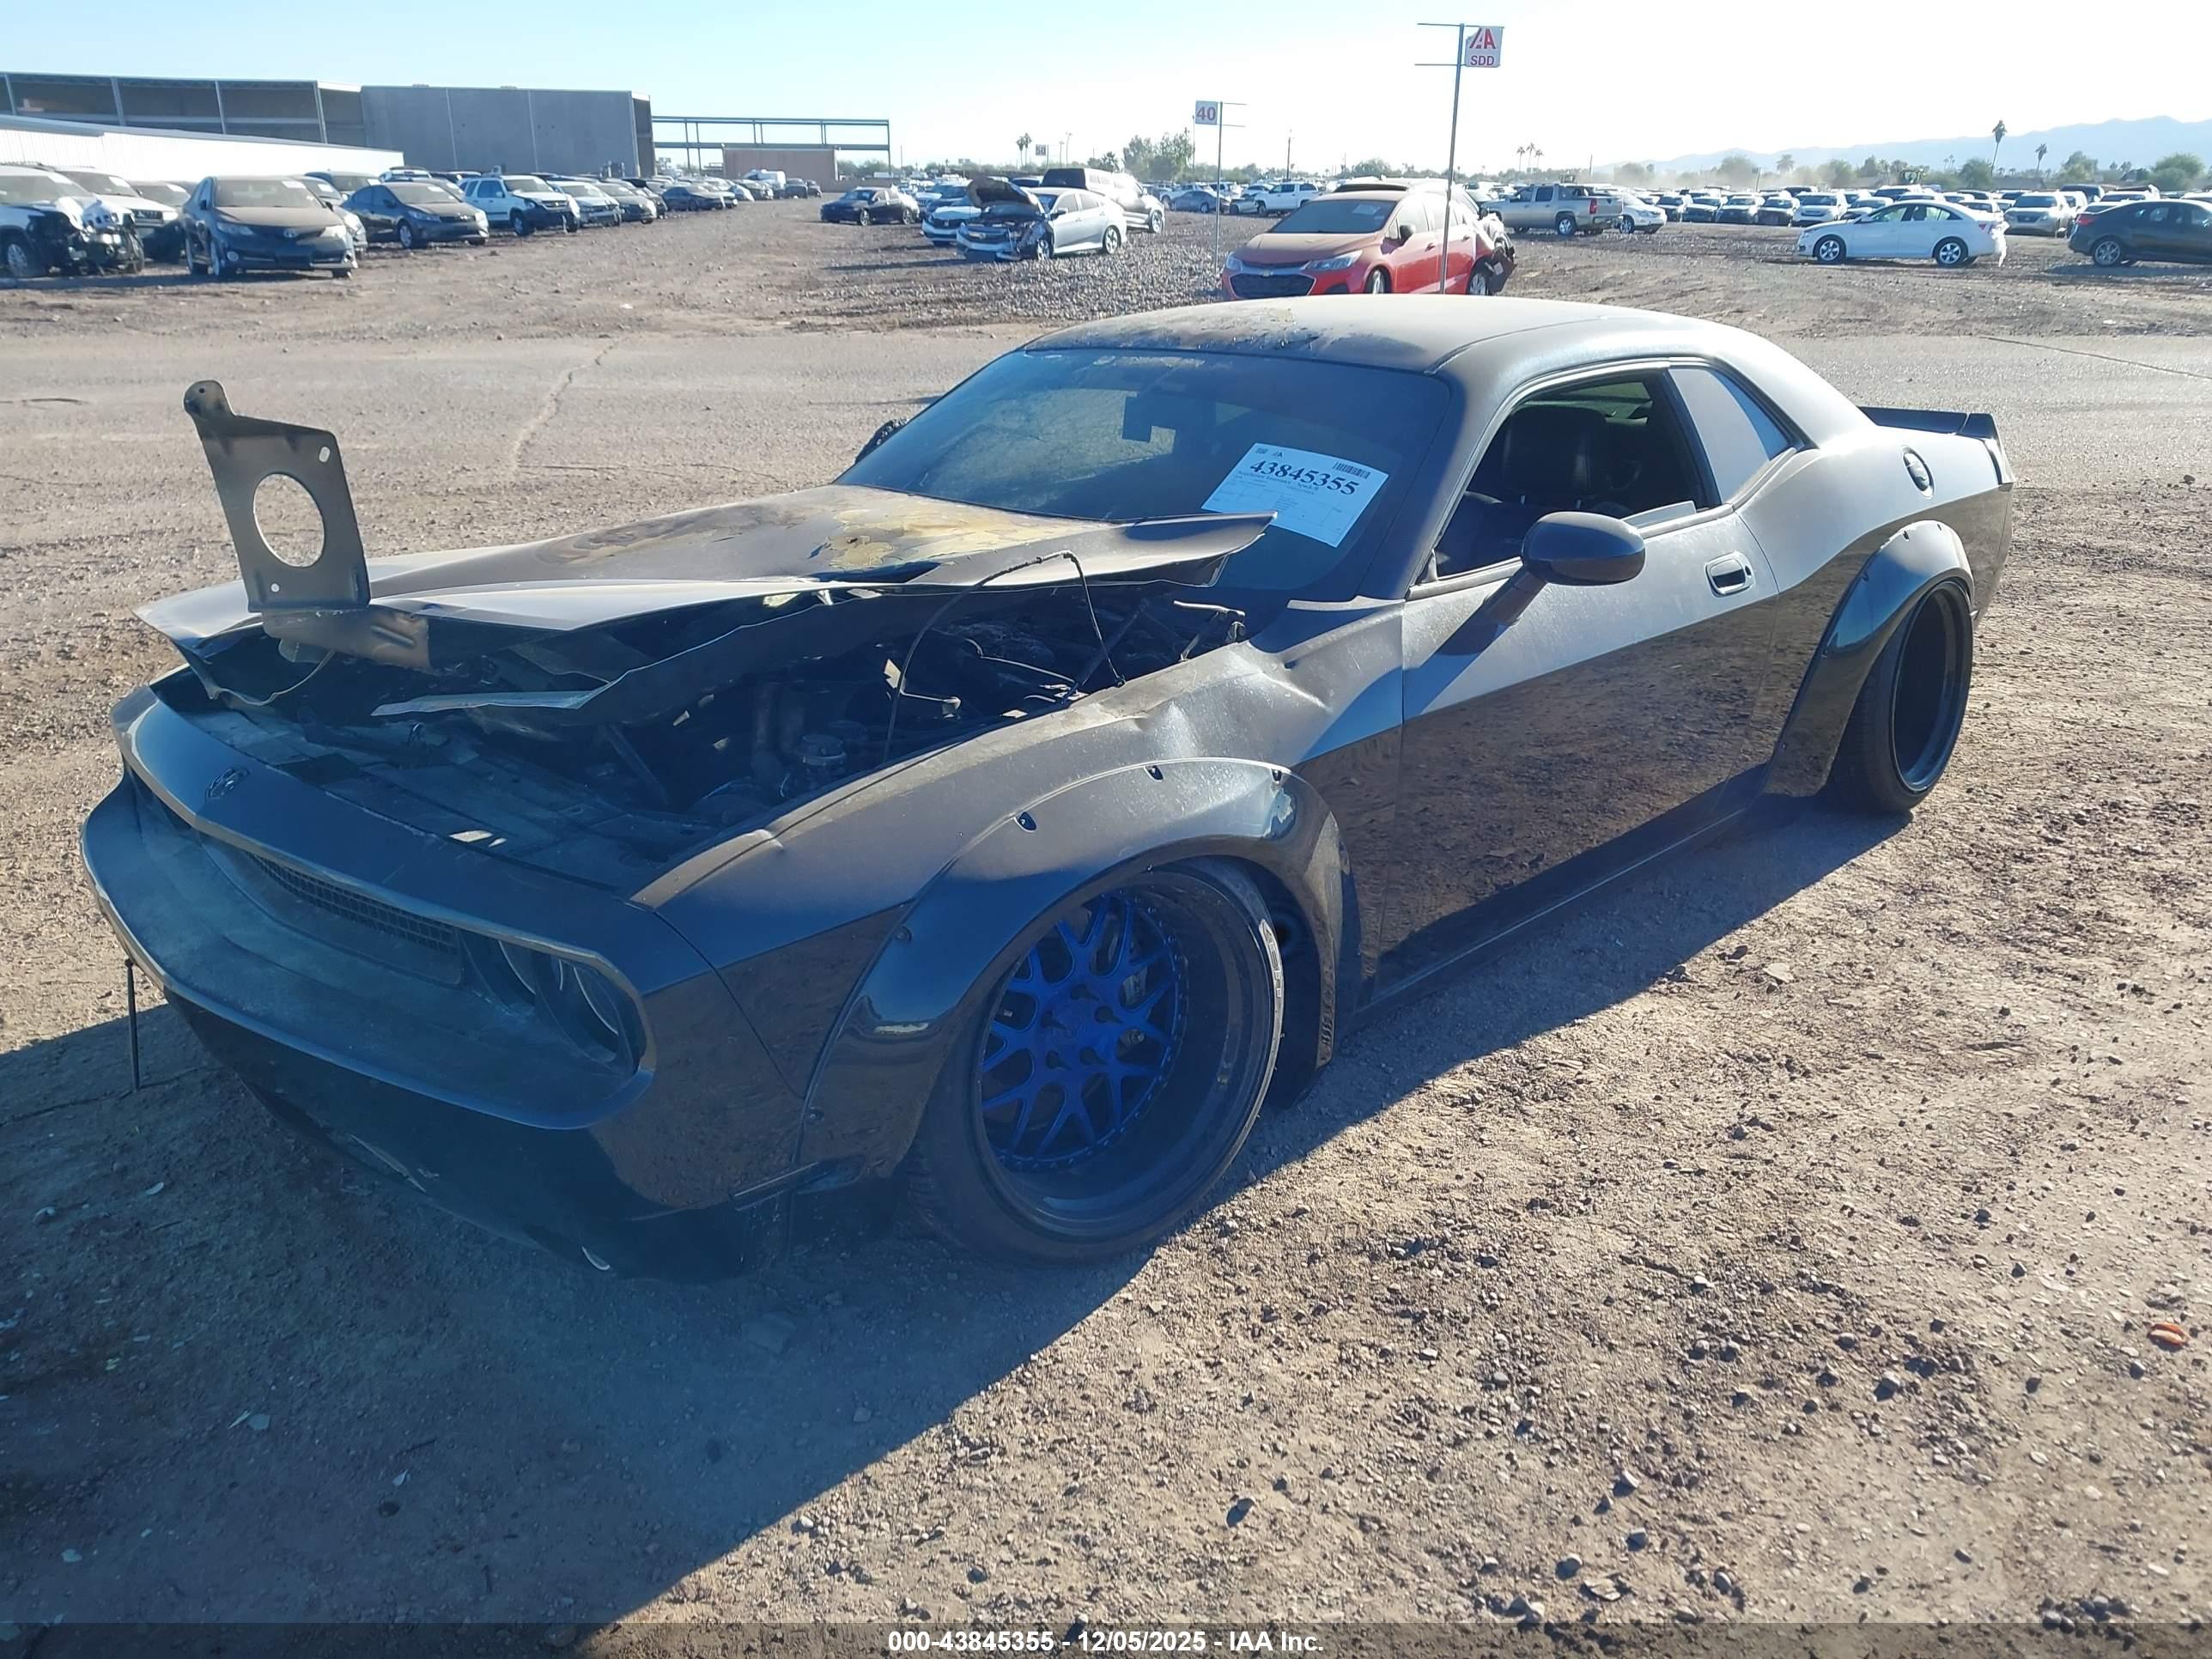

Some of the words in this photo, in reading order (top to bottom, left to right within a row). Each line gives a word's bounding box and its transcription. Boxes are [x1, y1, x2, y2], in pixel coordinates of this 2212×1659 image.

[1469, 55, 1495, 66] SDD
[1196, 106, 1216, 121] 40
[1250, 459, 1360, 495] 43845355
